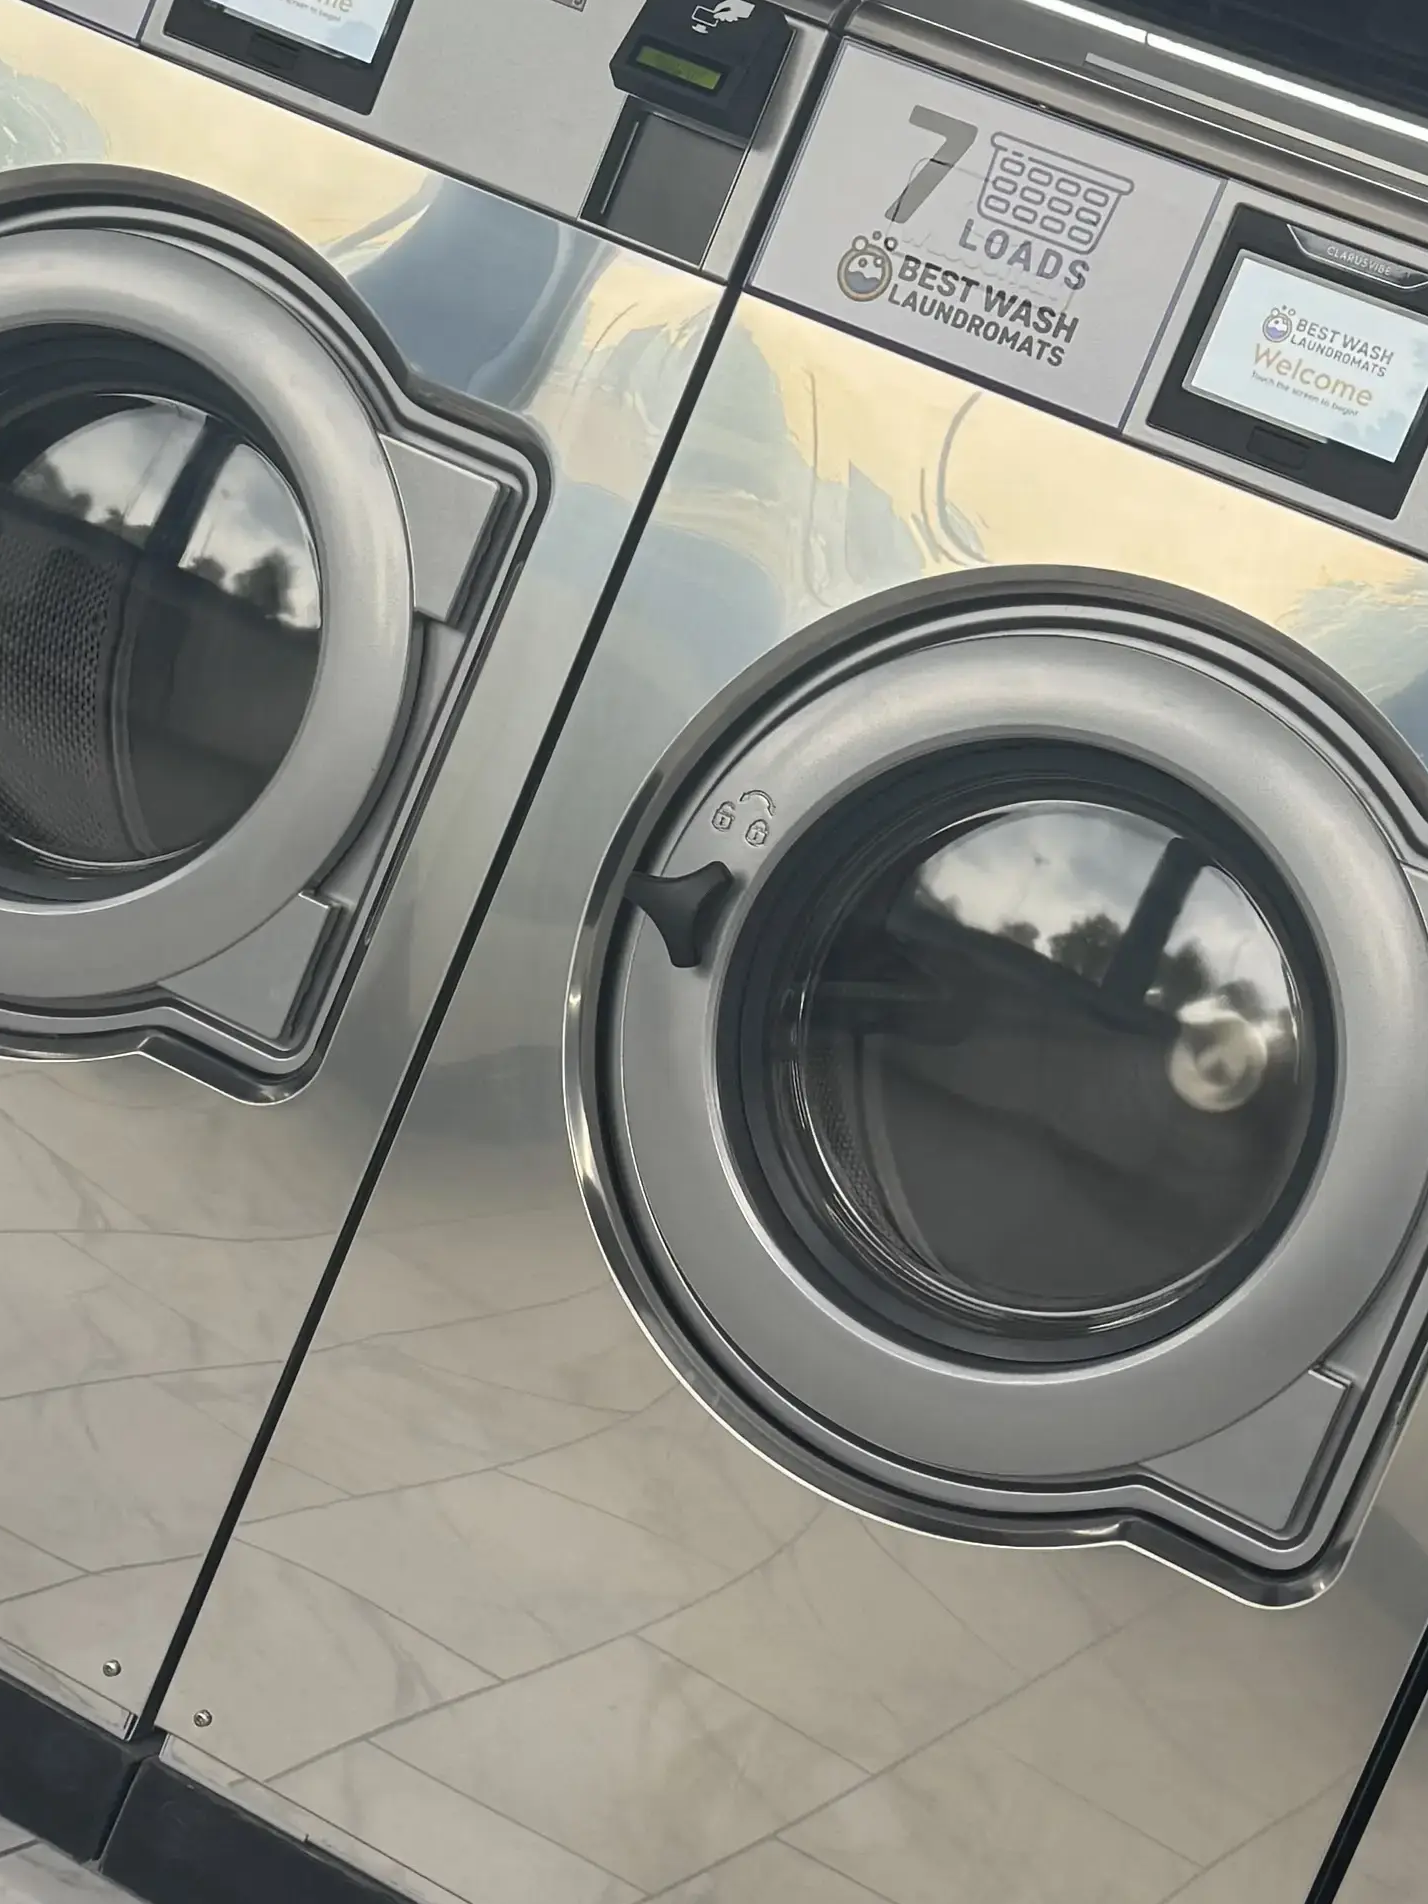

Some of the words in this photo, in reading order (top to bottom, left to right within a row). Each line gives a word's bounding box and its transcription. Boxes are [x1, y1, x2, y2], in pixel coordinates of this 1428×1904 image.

[884, 104, 978, 224] 7
[958, 218, 1090, 291] LOADS
[1327, 246, 1392, 276] CLARUSVIBE
[888, 284, 1065, 367] LAUNDROMATS
[898, 255, 980, 303] BEST
[984, 285, 1080, 344] WASH
[1291, 334, 1387, 377] LAUNDROMATS
[1296, 318, 1341, 344] BEST
[1343, 333, 1394, 365] WASH
[1254, 343, 1373, 407] Welcome
[1276, 378, 1290, 392] the
[1292, 386, 1320, 402] screen
